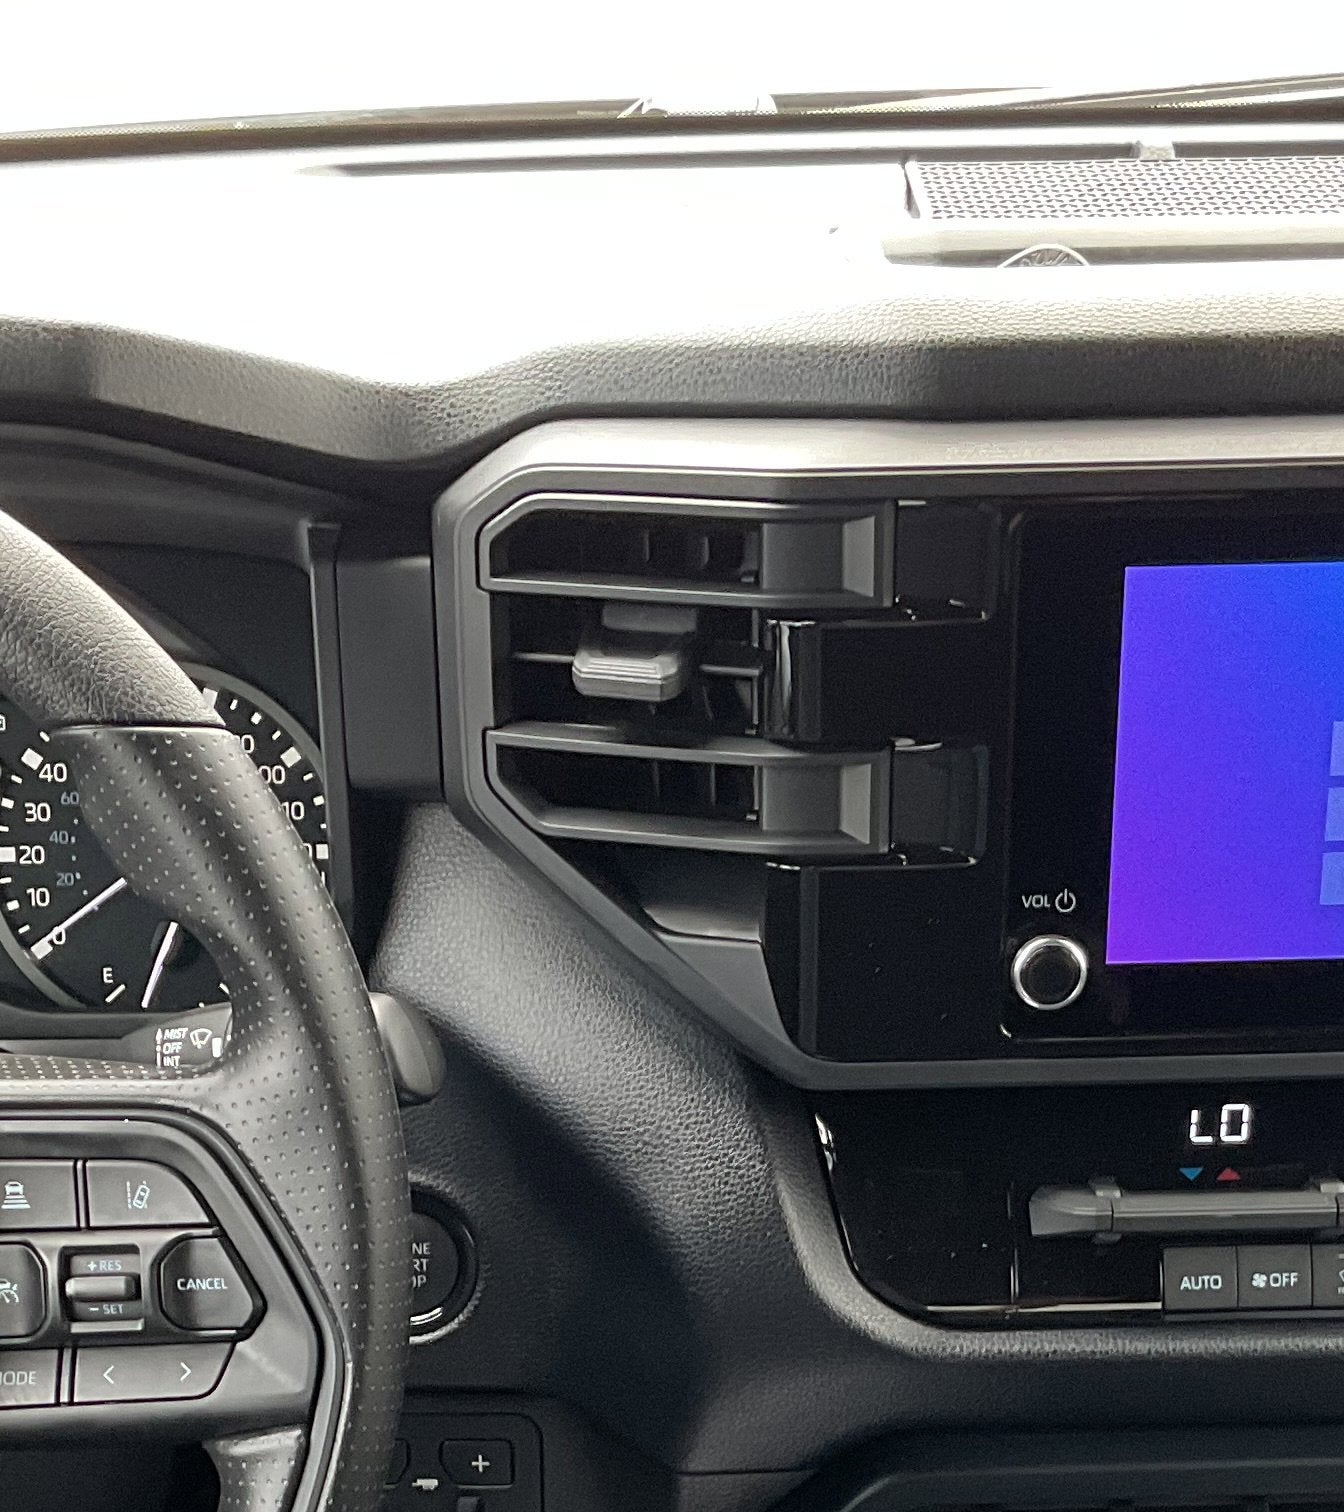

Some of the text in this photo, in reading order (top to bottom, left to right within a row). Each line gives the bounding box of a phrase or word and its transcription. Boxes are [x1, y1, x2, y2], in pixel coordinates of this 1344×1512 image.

[235, 735, 255, 754] 0
[38, 763, 68, 784] 40
[59, 790, 80, 806] 60
[24, 802, 52, 824] 30
[48, 829, 70, 845] 40
[18, 844, 46, 866] 20
[25, 887, 50, 907] 10
[1021, 894, 1050, 910] VOL
[102, 966, 114, 985] E
[163, 1027, 189, 1041] MIST
[162, 1041, 183, 1055] OFF
[161, 1054, 181, 1068] INT
[1187, 1102, 1252, 1145] LO
[176, 1276, 229, 1292] CANCEL
[1179, 1273, 1223, 1291] AUTO
[1269, 1271, 1299, 1289] OFF
[102, 1303, 125, 1316] SET
